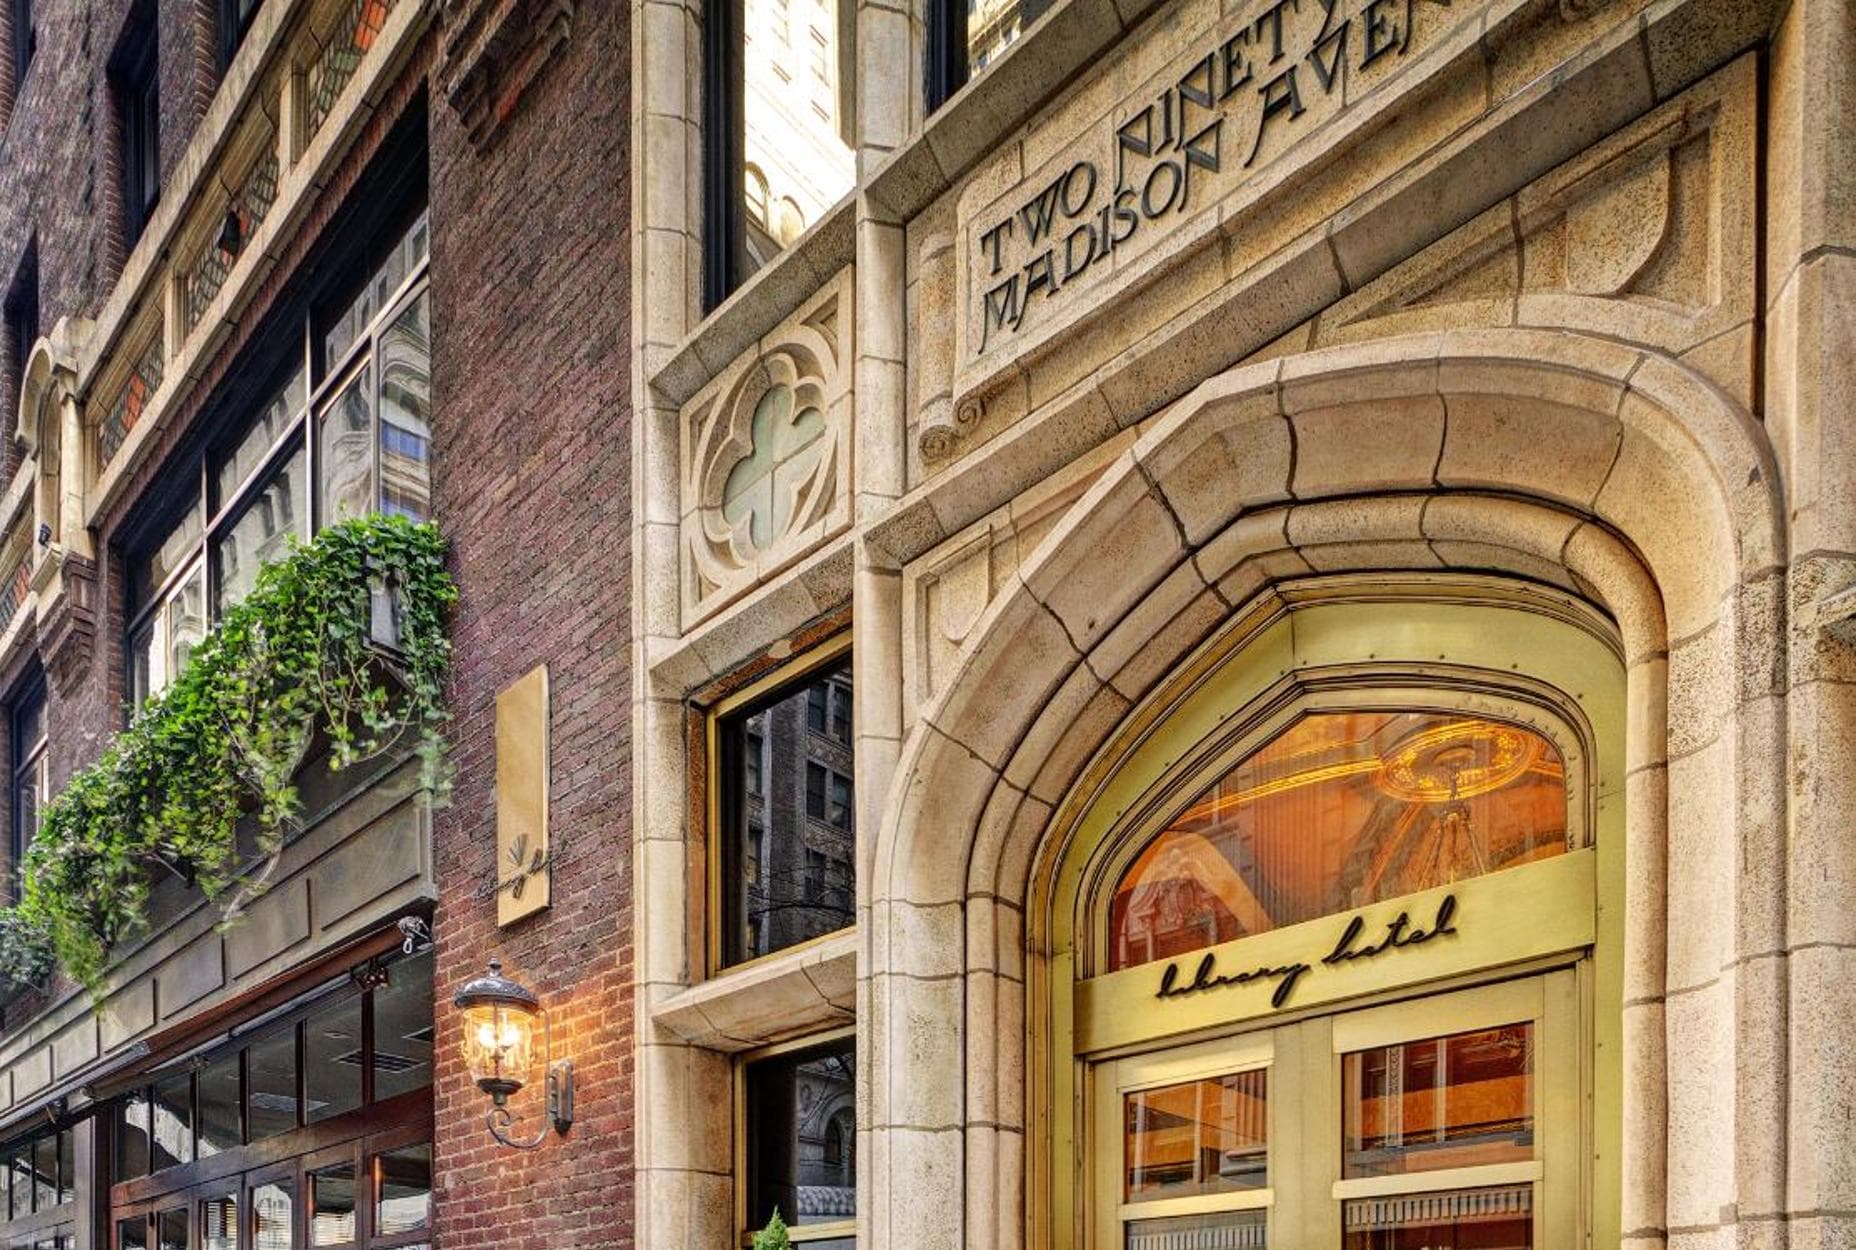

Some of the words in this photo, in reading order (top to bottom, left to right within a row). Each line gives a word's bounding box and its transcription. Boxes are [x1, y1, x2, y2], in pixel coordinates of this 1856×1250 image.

[978, 117, 1225, 355] MADISON
[980, 160, 1098, 277] TWO
[1113, 0, 1336, 196] NINETY
[1321, 894, 1458, 965] hotel
